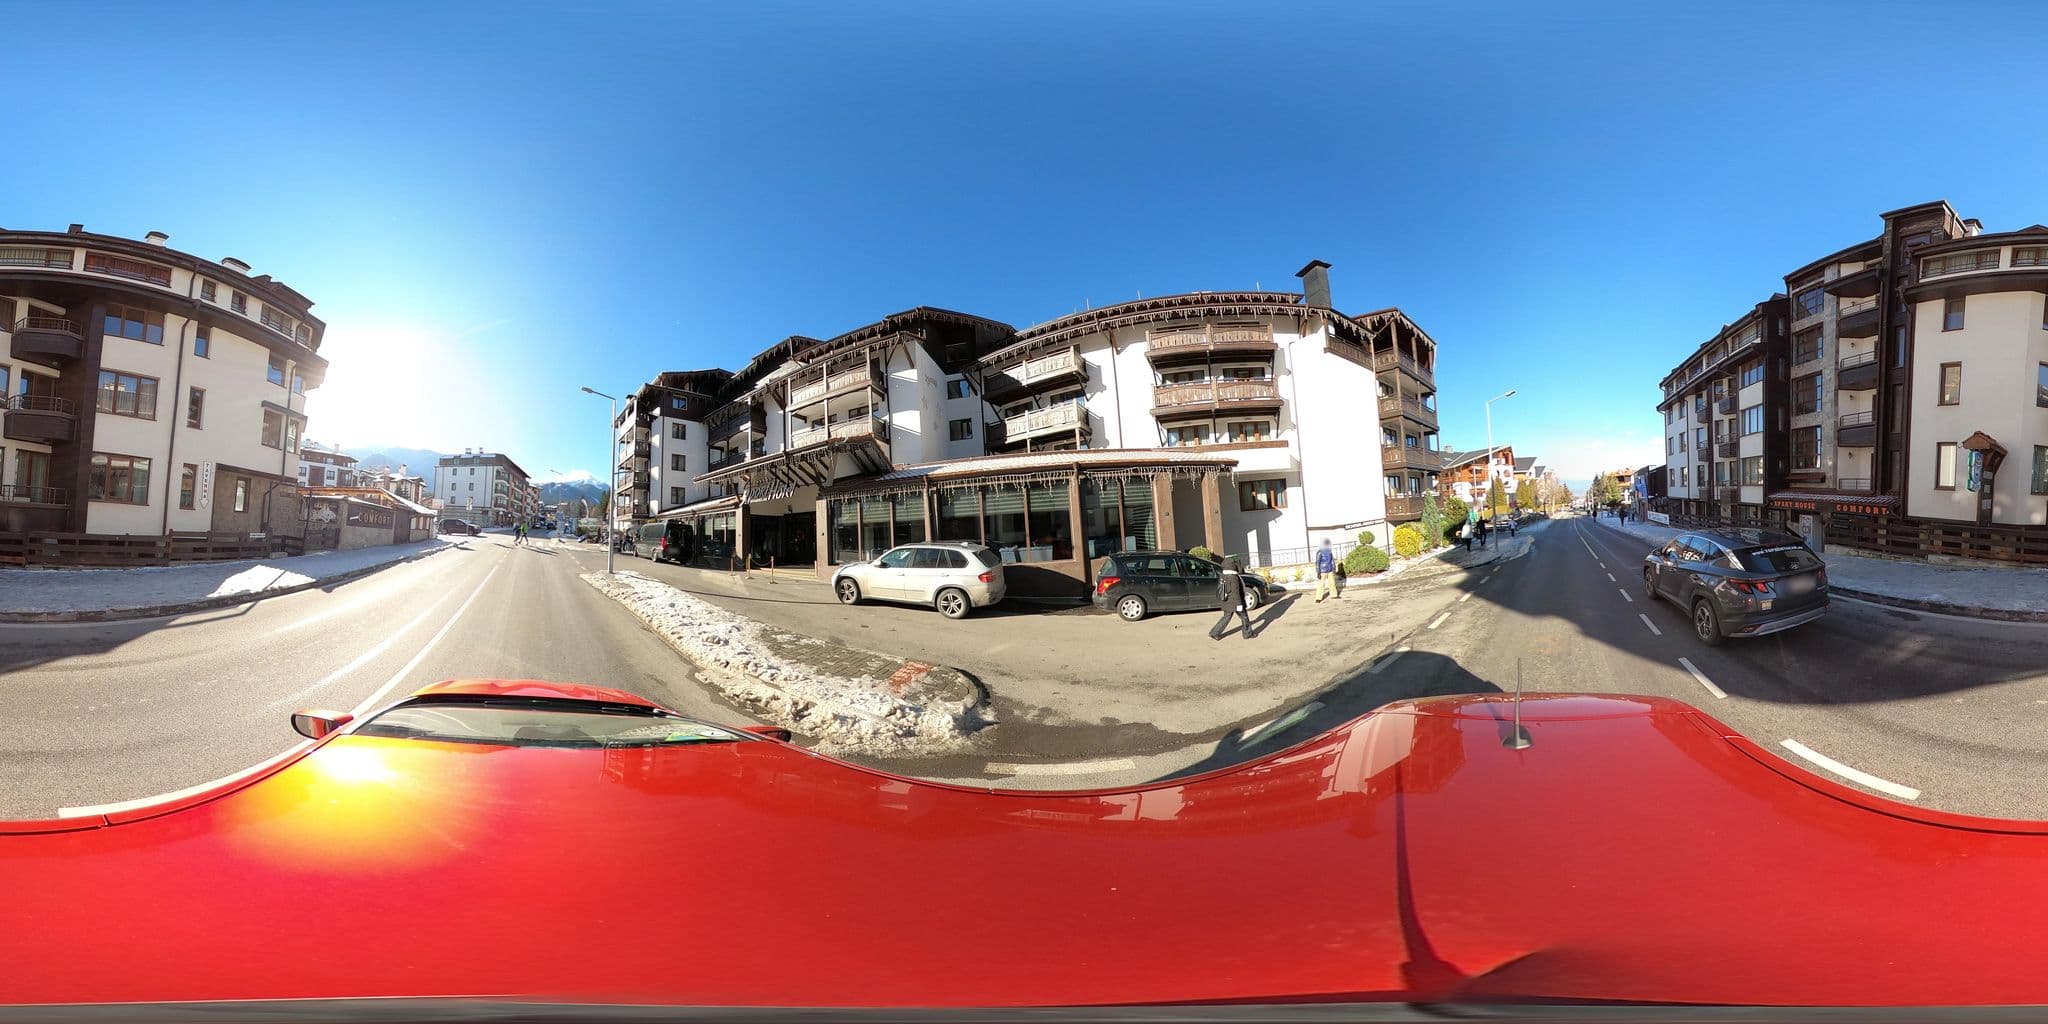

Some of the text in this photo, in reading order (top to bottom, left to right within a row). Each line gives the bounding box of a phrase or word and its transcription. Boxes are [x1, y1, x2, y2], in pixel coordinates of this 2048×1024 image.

[1794, 501, 1815, 509] HOUSE
[1836, 504, 1888, 515] COMFORT
[358, 511, 391, 524] COMFORT
